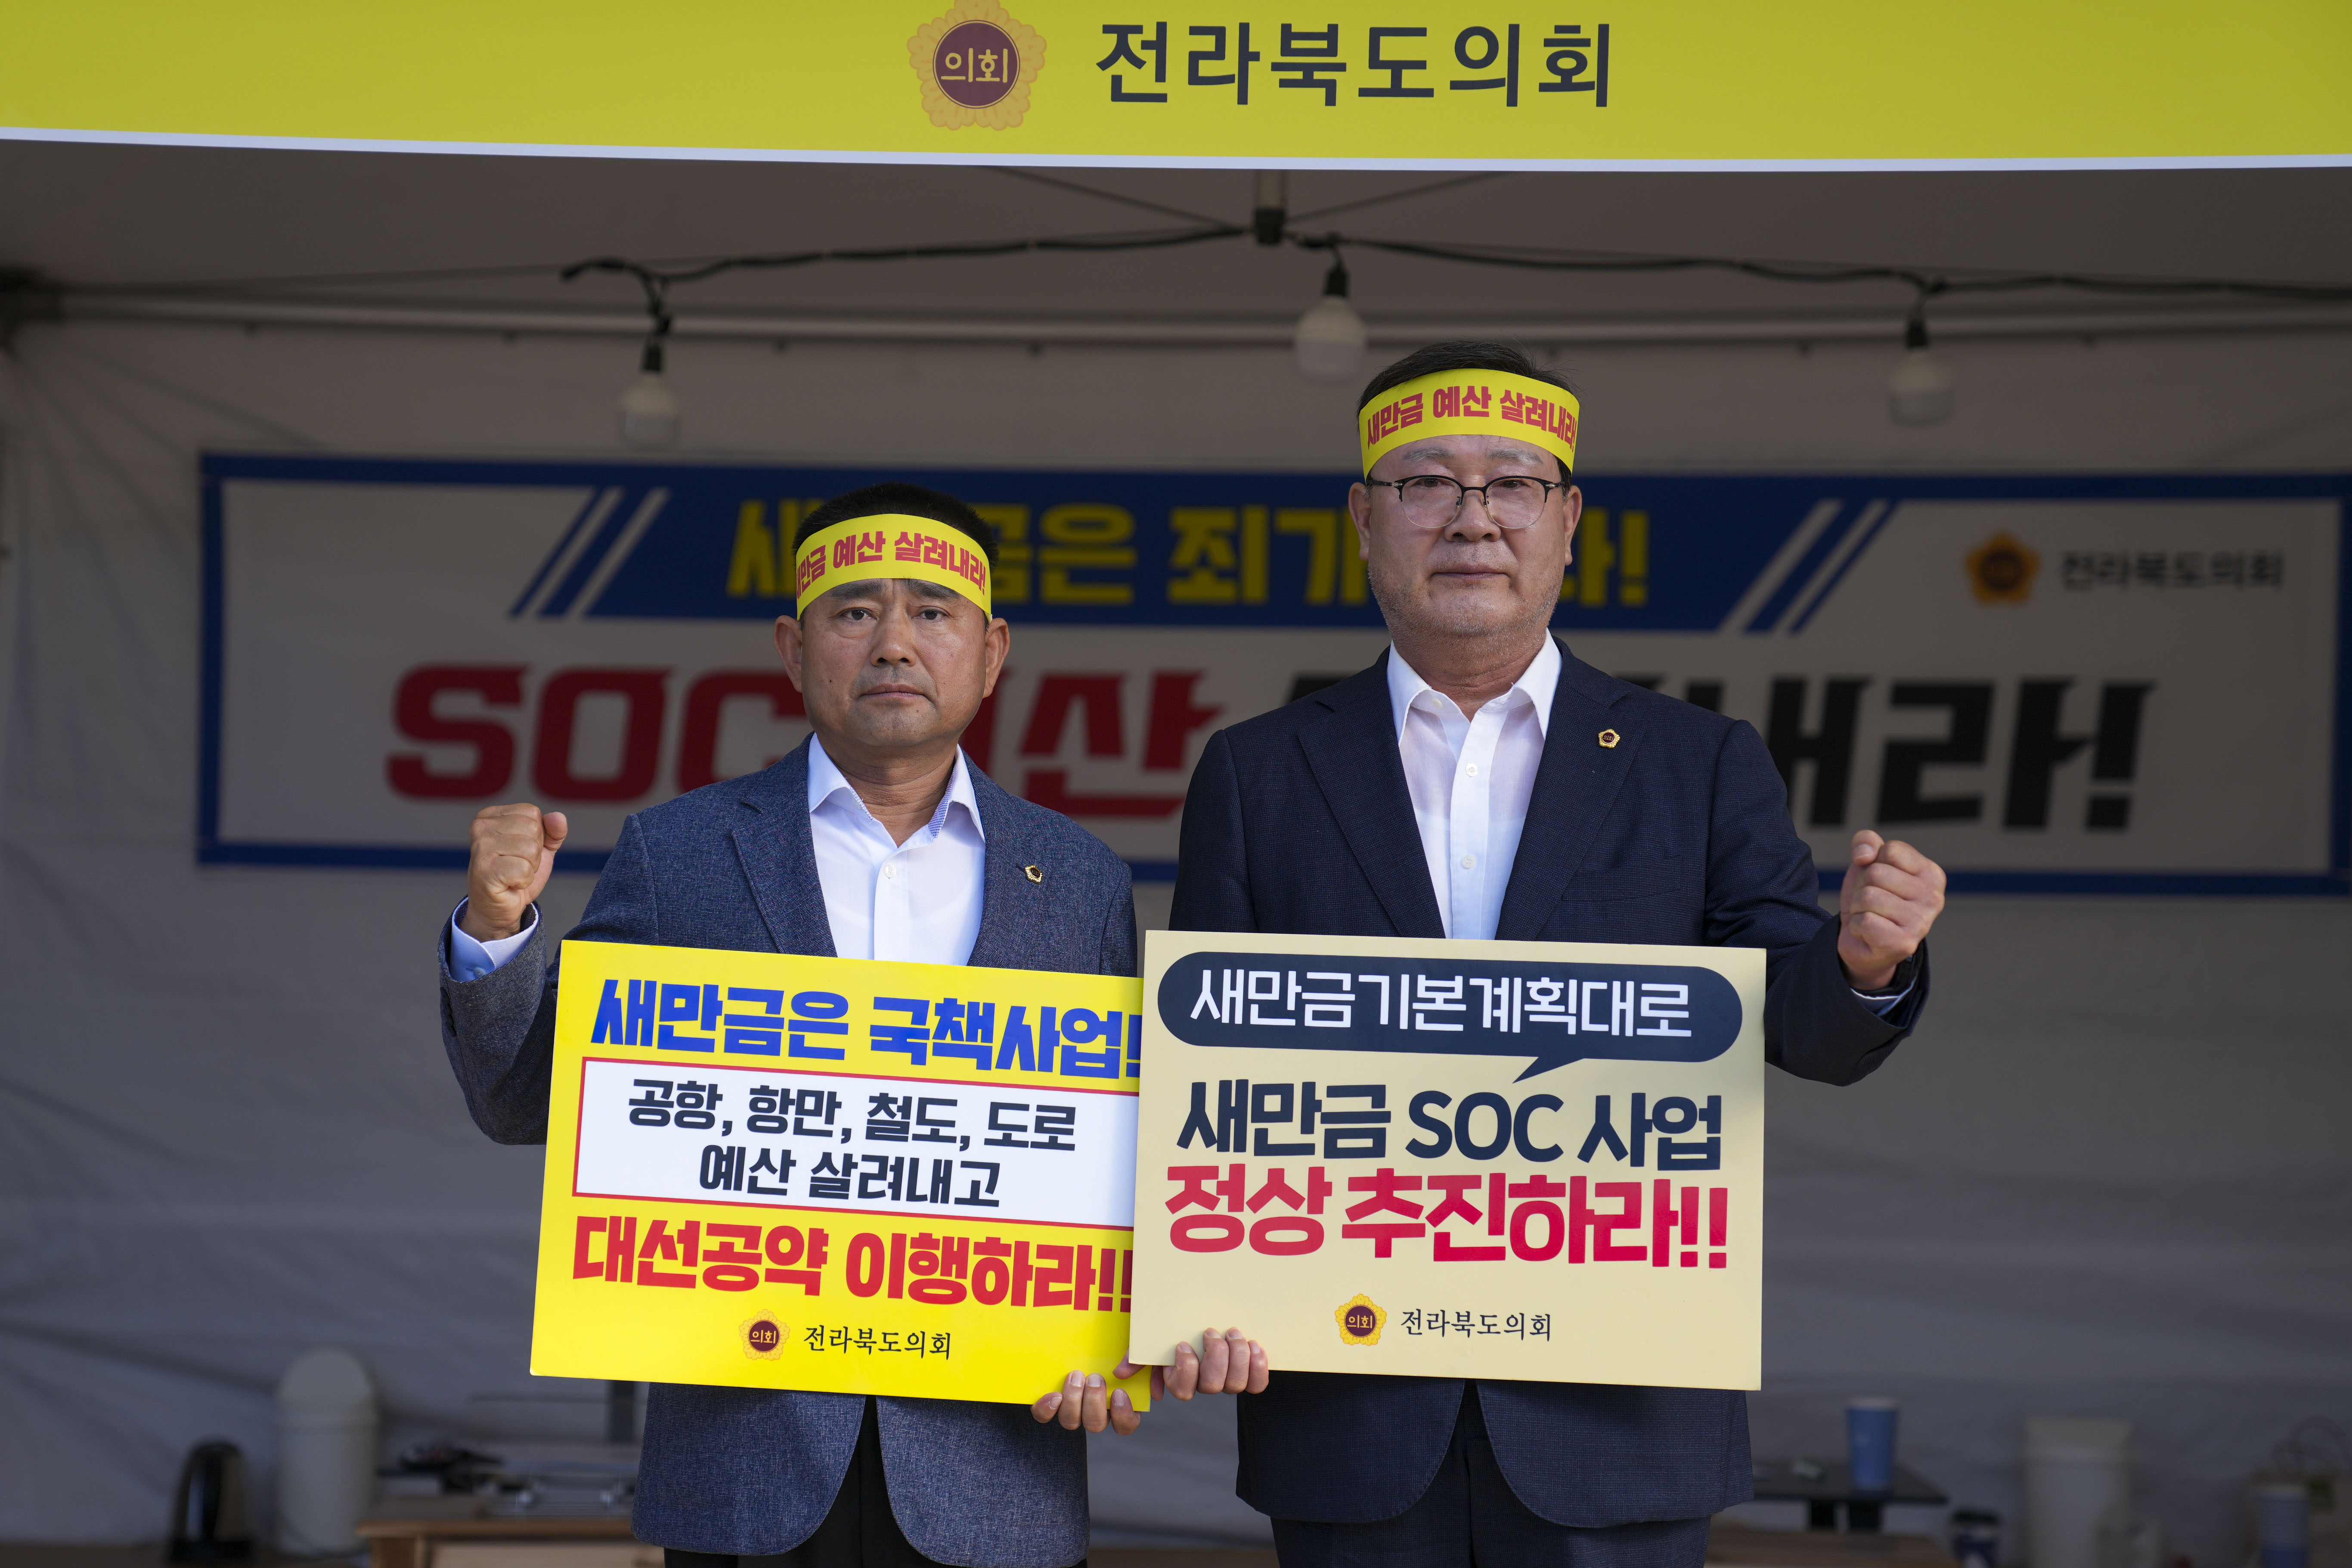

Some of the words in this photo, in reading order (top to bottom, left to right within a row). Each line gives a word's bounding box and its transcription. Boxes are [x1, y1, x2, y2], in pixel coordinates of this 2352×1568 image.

[941, 48, 1008, 83] 의회
[1096, 22, 1610, 107] 전라북도의회
[1368, 393, 1424, 450] 새만금
[1433, 385, 1492, 418] 예산
[1500, 389, 1577, 453] 살려내라!
[833, 531, 886, 568] 예산
[894, 531, 986, 595] 살려내라!
[591, 979, 849, 1060] 새만금은
[870, 997, 1142, 1079] 국책사업!
[1190, 969, 1692, 1037] 새만금기본계획대로
[629, 1078, 733, 1135] 공항,
[747, 1085, 852, 1143] 항만,
[866, 1093, 970, 1151] 철도,
[984, 1101, 1076, 1151] 도로
[1176, 1079, 1391, 1159] 새만금
[1405, 1091, 1564, 1162] SOC
[1577, 1092, 1722, 1171] 사업
[700, 1144, 796, 1196] 예산
[809, 1152, 1000, 1207] 살려내고
[1165, 1163, 1332, 1256] 정상
[1342, 1168, 1728, 1269] 추진하라!!
[573, 1215, 829, 1296] 대선공약
[846, 1231, 1134, 1313] 이행하라!!
[750, 1330, 776, 1344] 의회
[804, 1324, 951, 1360] 전라북도의회
[1347, 1315, 1373, 1329] 의회
[1401, 1308, 1551, 1342] 전라북도의회
